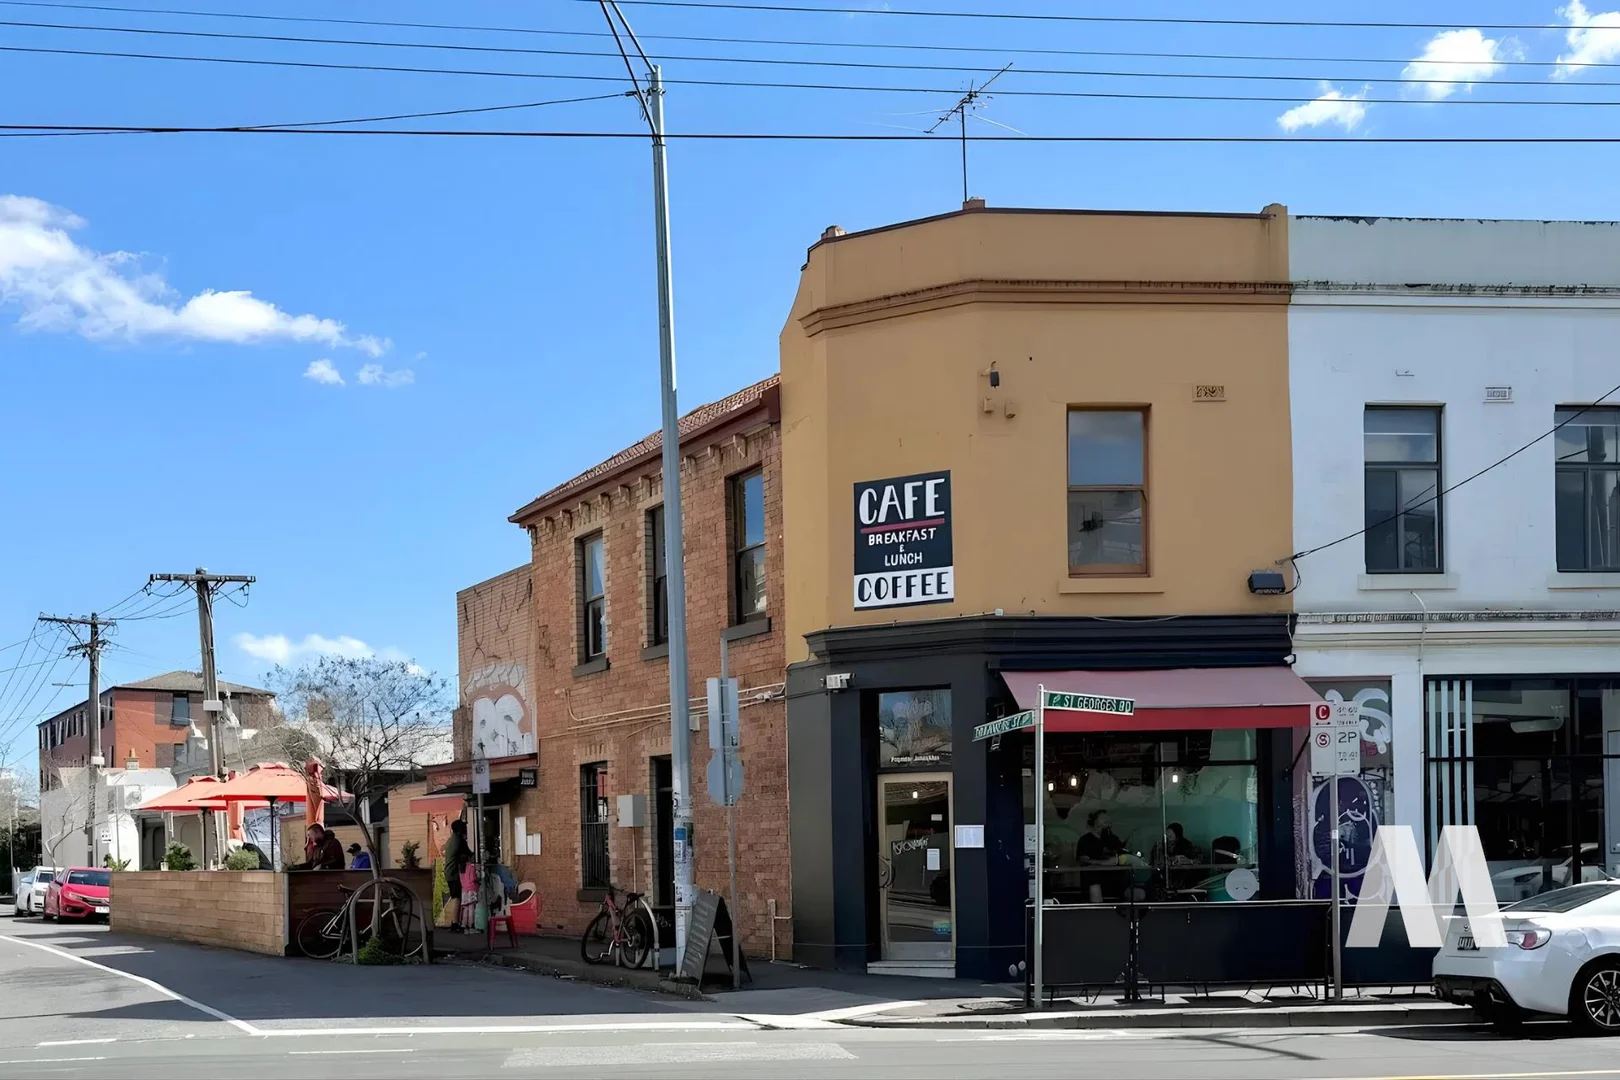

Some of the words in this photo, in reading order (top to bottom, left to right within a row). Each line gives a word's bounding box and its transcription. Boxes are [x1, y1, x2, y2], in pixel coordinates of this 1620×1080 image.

[859, 478, 946, 525] CAFE
[868, 528, 937, 546] BREAKFAST
[884, 552, 923, 566] LUNCH
[858, 572, 949, 602] COFFEE
[1077, 697, 1117, 712] GEORGES
[1338, 731, 1357, 743] 2P
